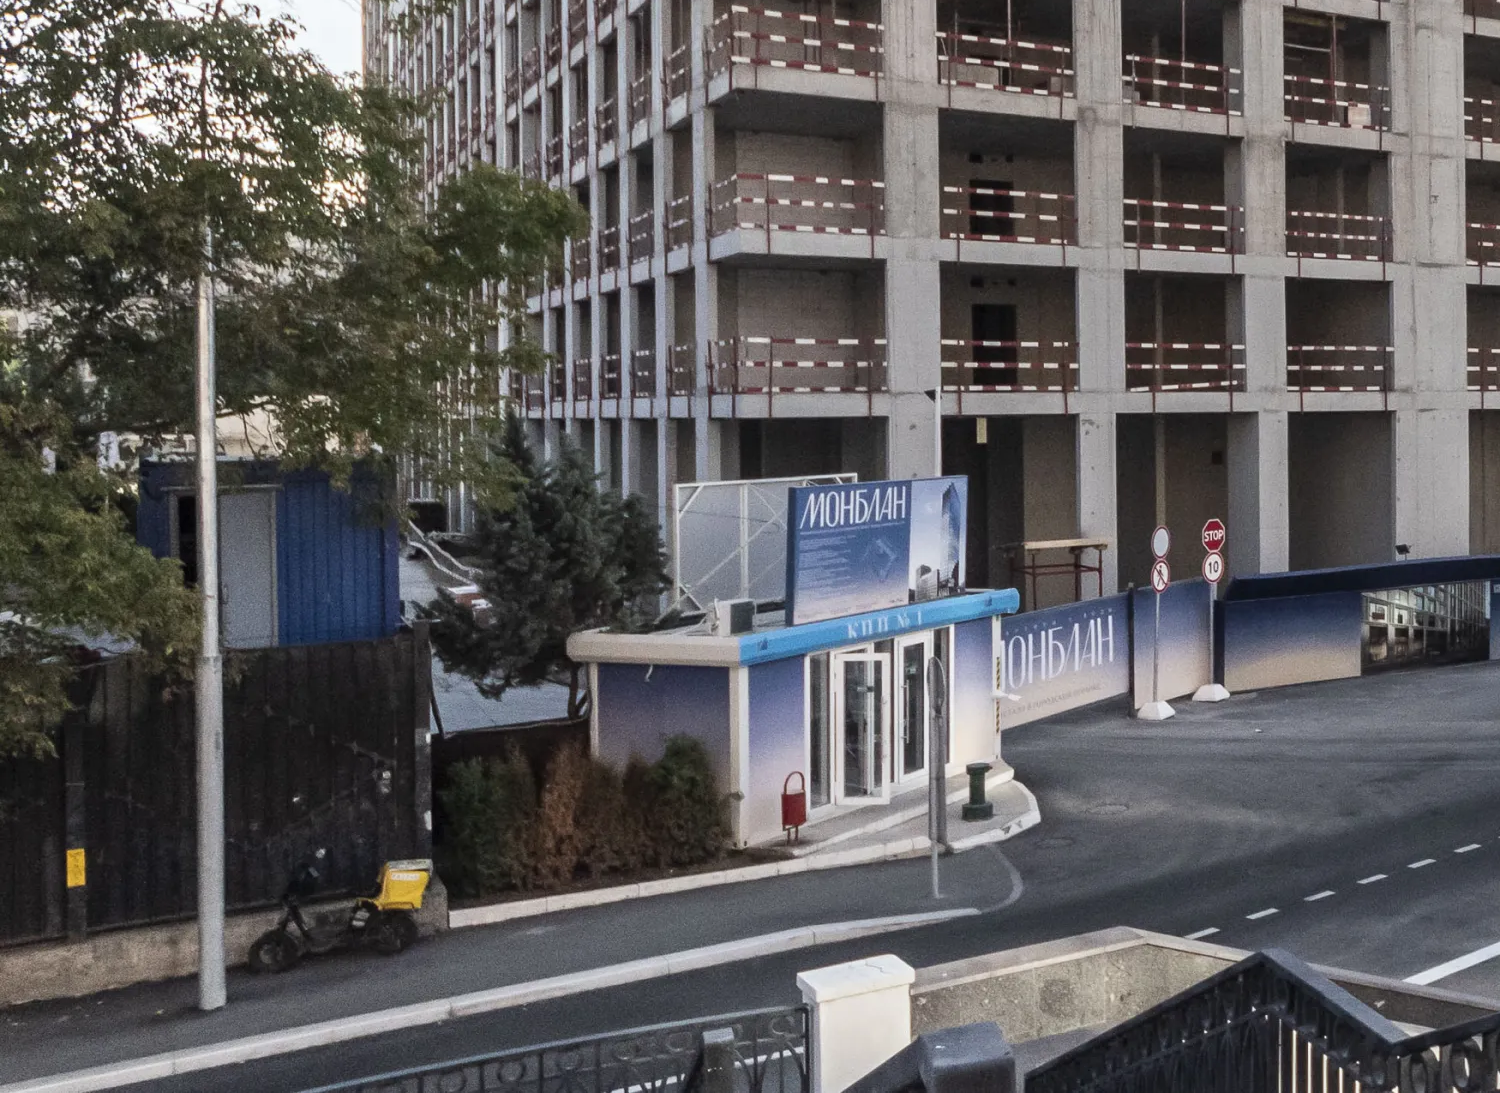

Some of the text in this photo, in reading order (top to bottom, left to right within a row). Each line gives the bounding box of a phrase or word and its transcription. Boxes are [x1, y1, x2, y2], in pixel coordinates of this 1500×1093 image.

[799, 485, 906, 529] МОНБЛАН
[1204, 530, 1224, 542] STOP
[1208, 561, 1219, 574] 10
[1000, 615, 1114, 693] ОНБЛАН
